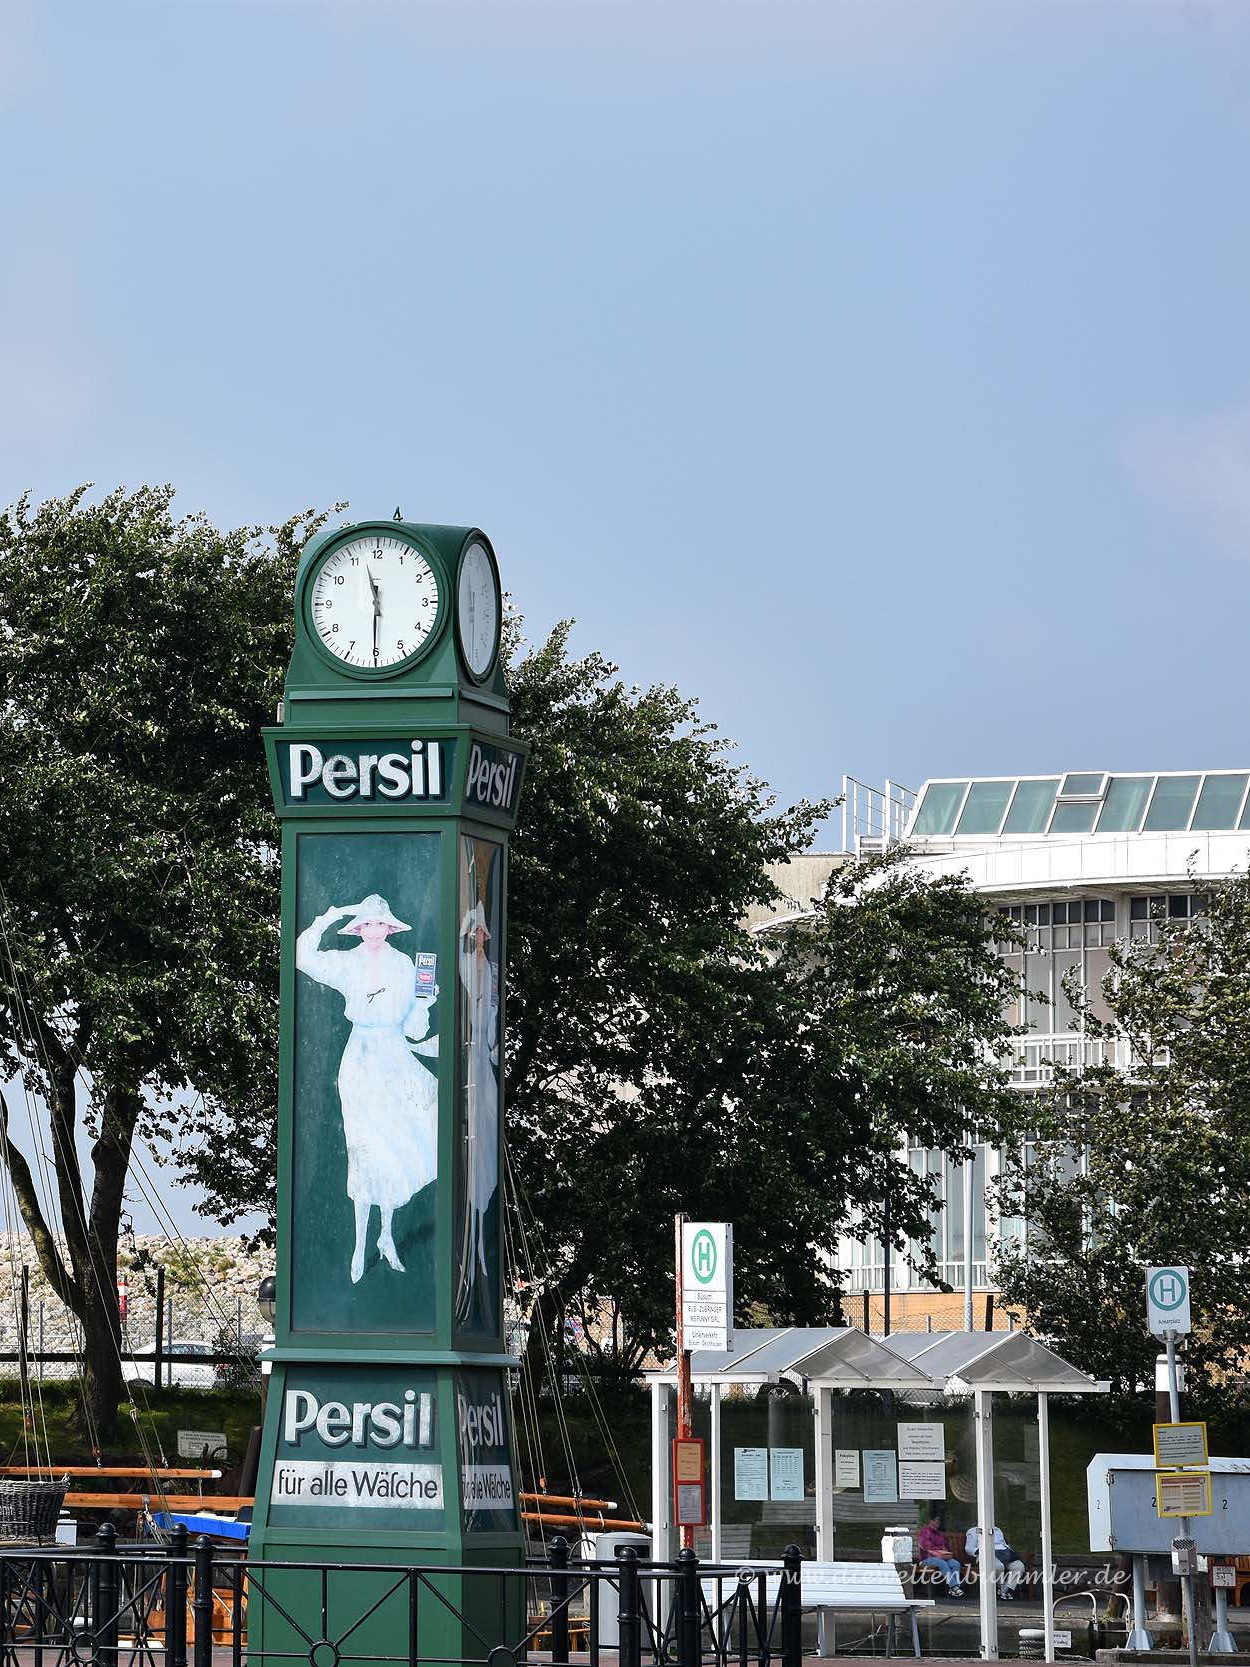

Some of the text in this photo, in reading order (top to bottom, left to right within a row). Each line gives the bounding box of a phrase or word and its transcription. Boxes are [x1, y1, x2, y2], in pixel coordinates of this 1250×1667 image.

[372, 550, 383, 560] 12
[350, 557, 359, 566] 11
[399, 556, 403, 565] 1
[332, 576, 344, 585] 10
[416, 574, 422, 583] 2
[326, 600, 332, 609] 9
[422, 598, 428, 607] 3
[332, 624, 338, 633] 8
[415, 622, 421, 631] 4
[350, 641, 355, 650] 7
[397, 640, 403, 649] 5
[290, 740, 440, 797] Persil
[466, 744, 517, 808] Persil
[284, 1389, 431, 1445] Persil
[458, 1392, 504, 1447] Persil
[278, 1469, 305, 1495] für
[310, 1470, 348, 1497] alle
[1096, 1499, 1101, 1510] 2
[1152, 1496, 1158, 1508] 2
[1223, 1499, 1229, 1510] 2
